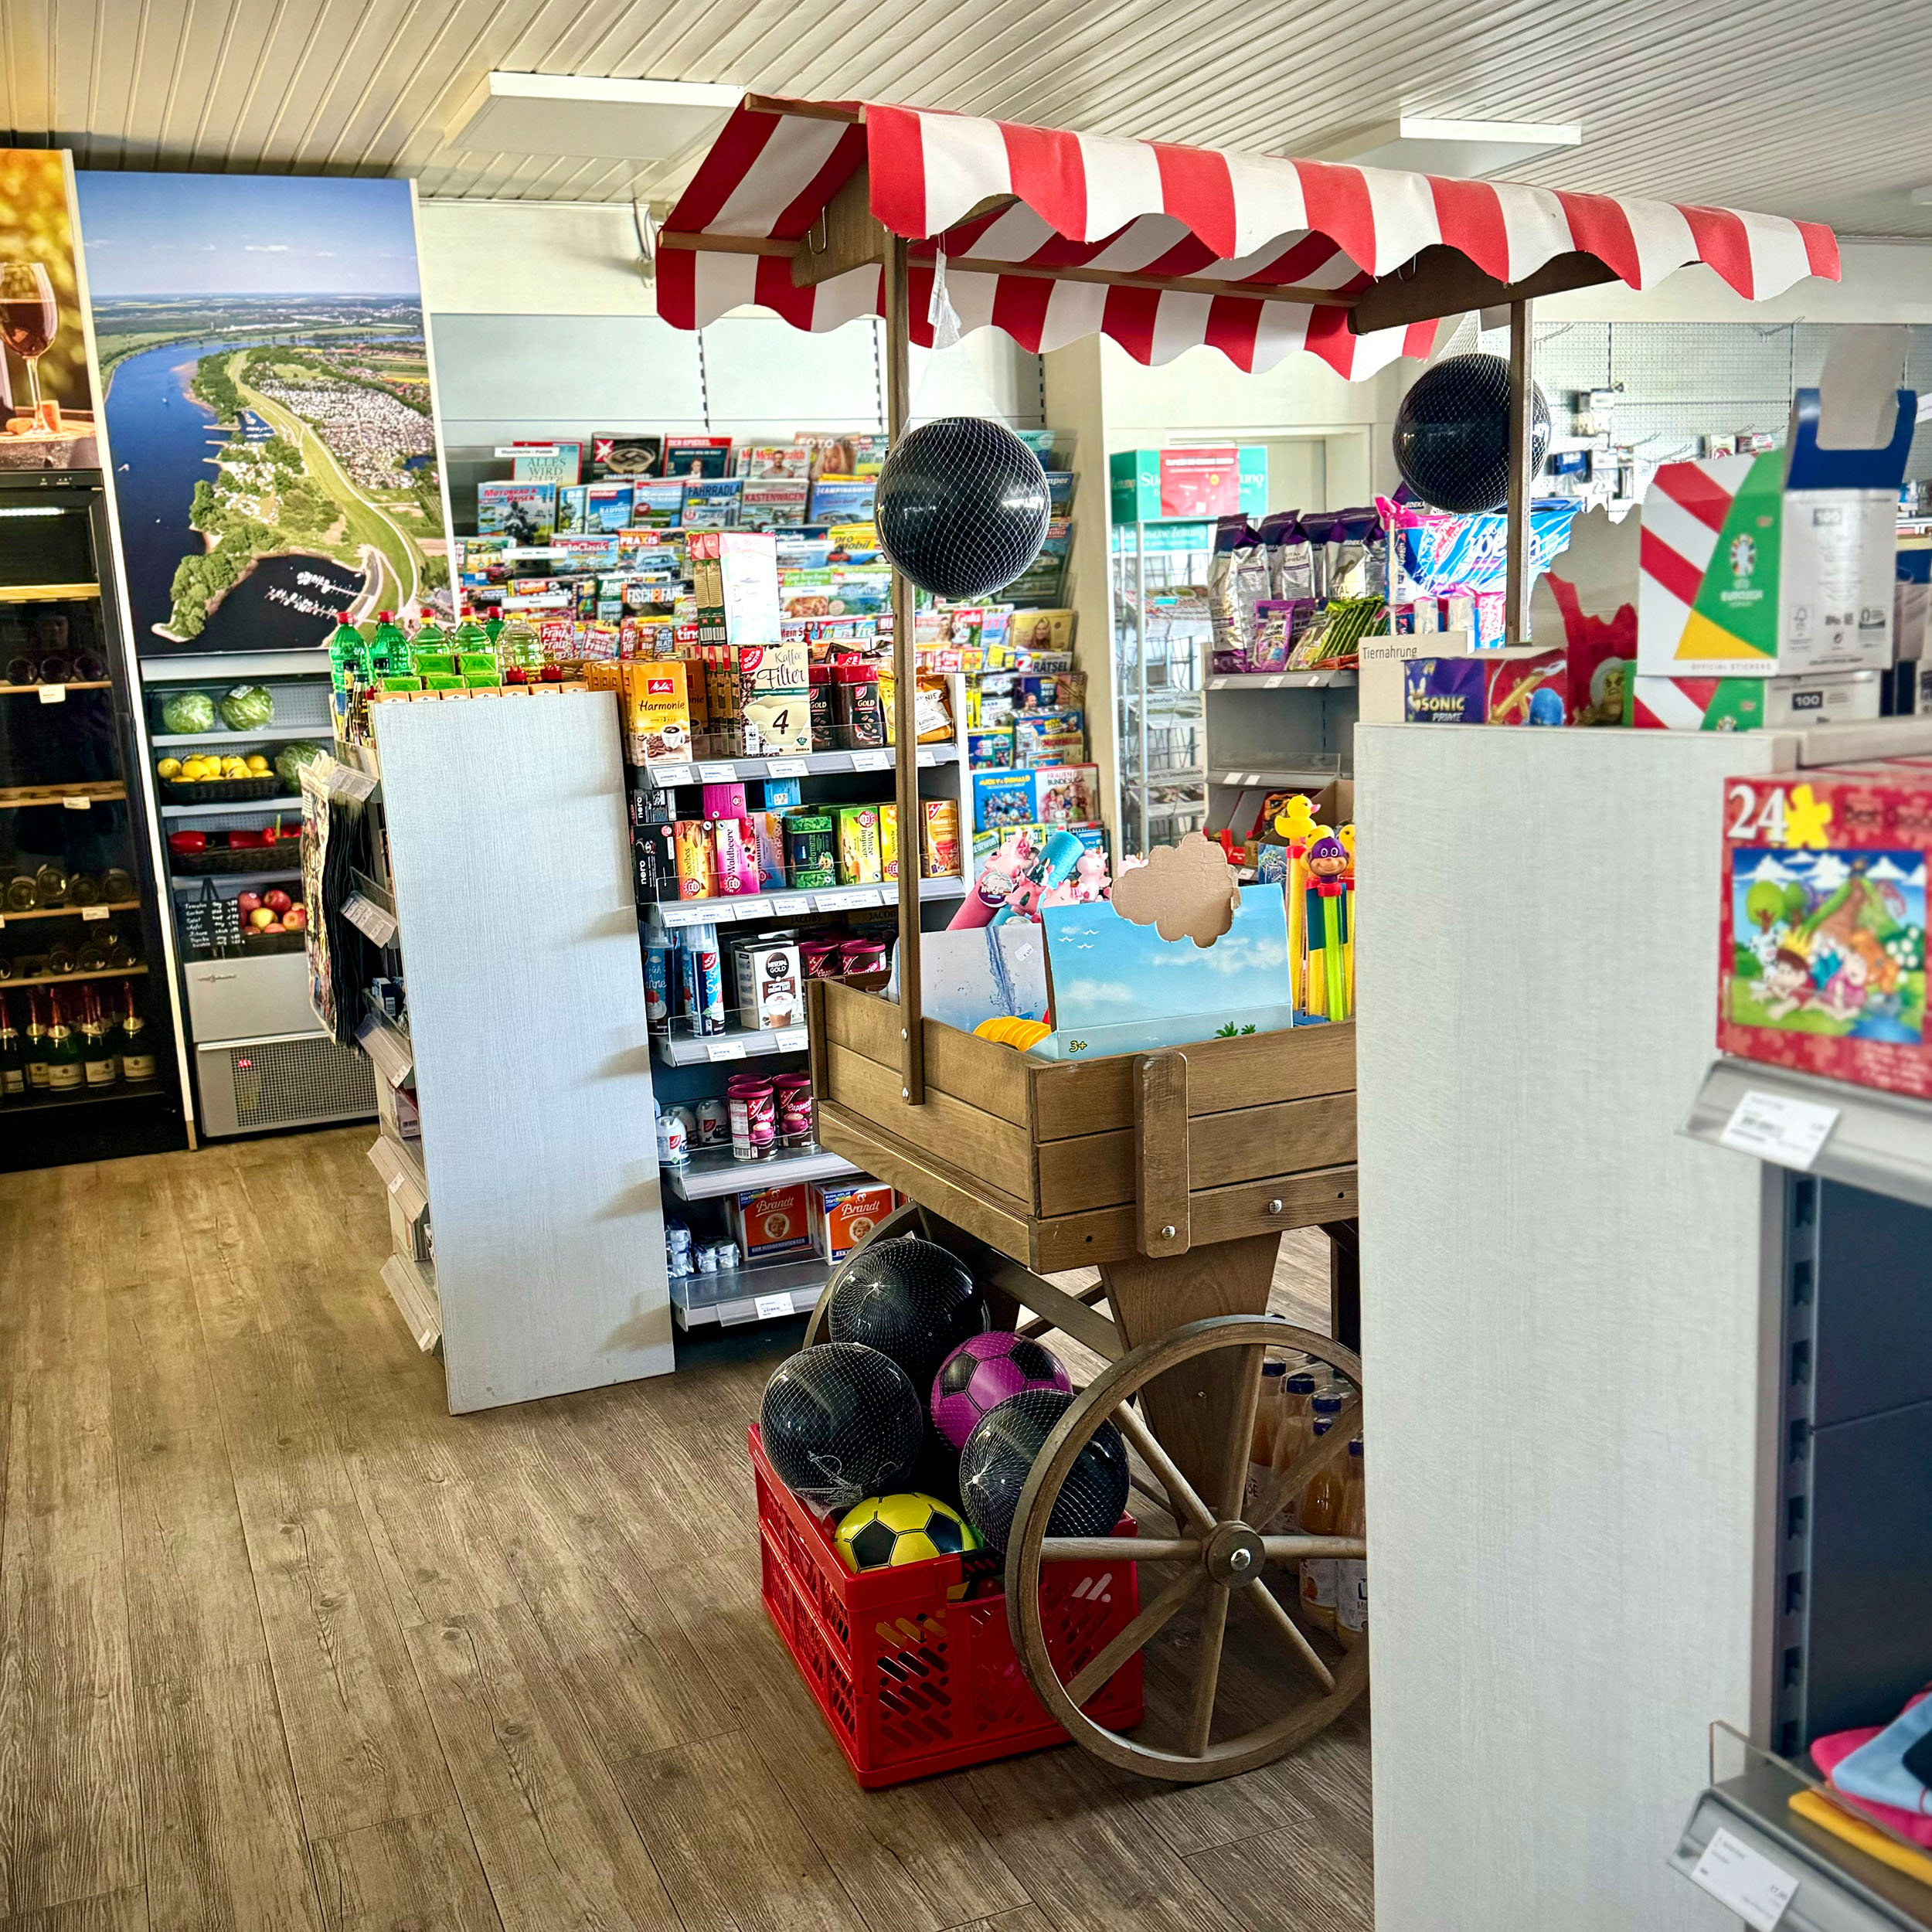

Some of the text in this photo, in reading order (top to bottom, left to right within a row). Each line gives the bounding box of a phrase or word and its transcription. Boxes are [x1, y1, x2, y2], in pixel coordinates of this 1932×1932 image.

[527, 457, 566, 467] ALLES
[529, 467, 563, 476] WIRD
[744, 492, 805, 502] KASTENWAGEN
[620, 536, 658, 546] PRAXIS
[835, 536, 854, 544] pro
[841, 541, 870, 549] mobil
[628, 589, 650, 604] FISCH
[662, 586, 684, 601] FANG
[954, 613, 981, 624] Gala
[543, 628, 565, 638] Frau
[543, 639, 568, 649] Frau
[585, 640, 607, 651] Frau
[775, 649, 802, 665] Kaffee
[1362, 646, 1417, 659] Tiernahrung
[1019, 658, 1032, 672] 2
[756, 664, 806, 689] Filter
[638, 699, 685, 712] Harmonie
[1421, 697, 1465, 711] SONIC
[1794, 696, 1820, 706] 100
[773, 709, 789, 735] 4
[1432, 712, 1464, 722] PRIME
[1726, 785, 1788, 843] 24
[726, 828, 736, 875] Waldbeere
[791, 915, 821, 924] JACOBS
[869, 909, 896, 920] JACOB
[770, 965, 787, 974] GOLD
[1070, 1040, 1088, 1053] 3+
[756, 1196, 794, 1215] Brandt
[841, 1200, 880, 1218] Brandt
